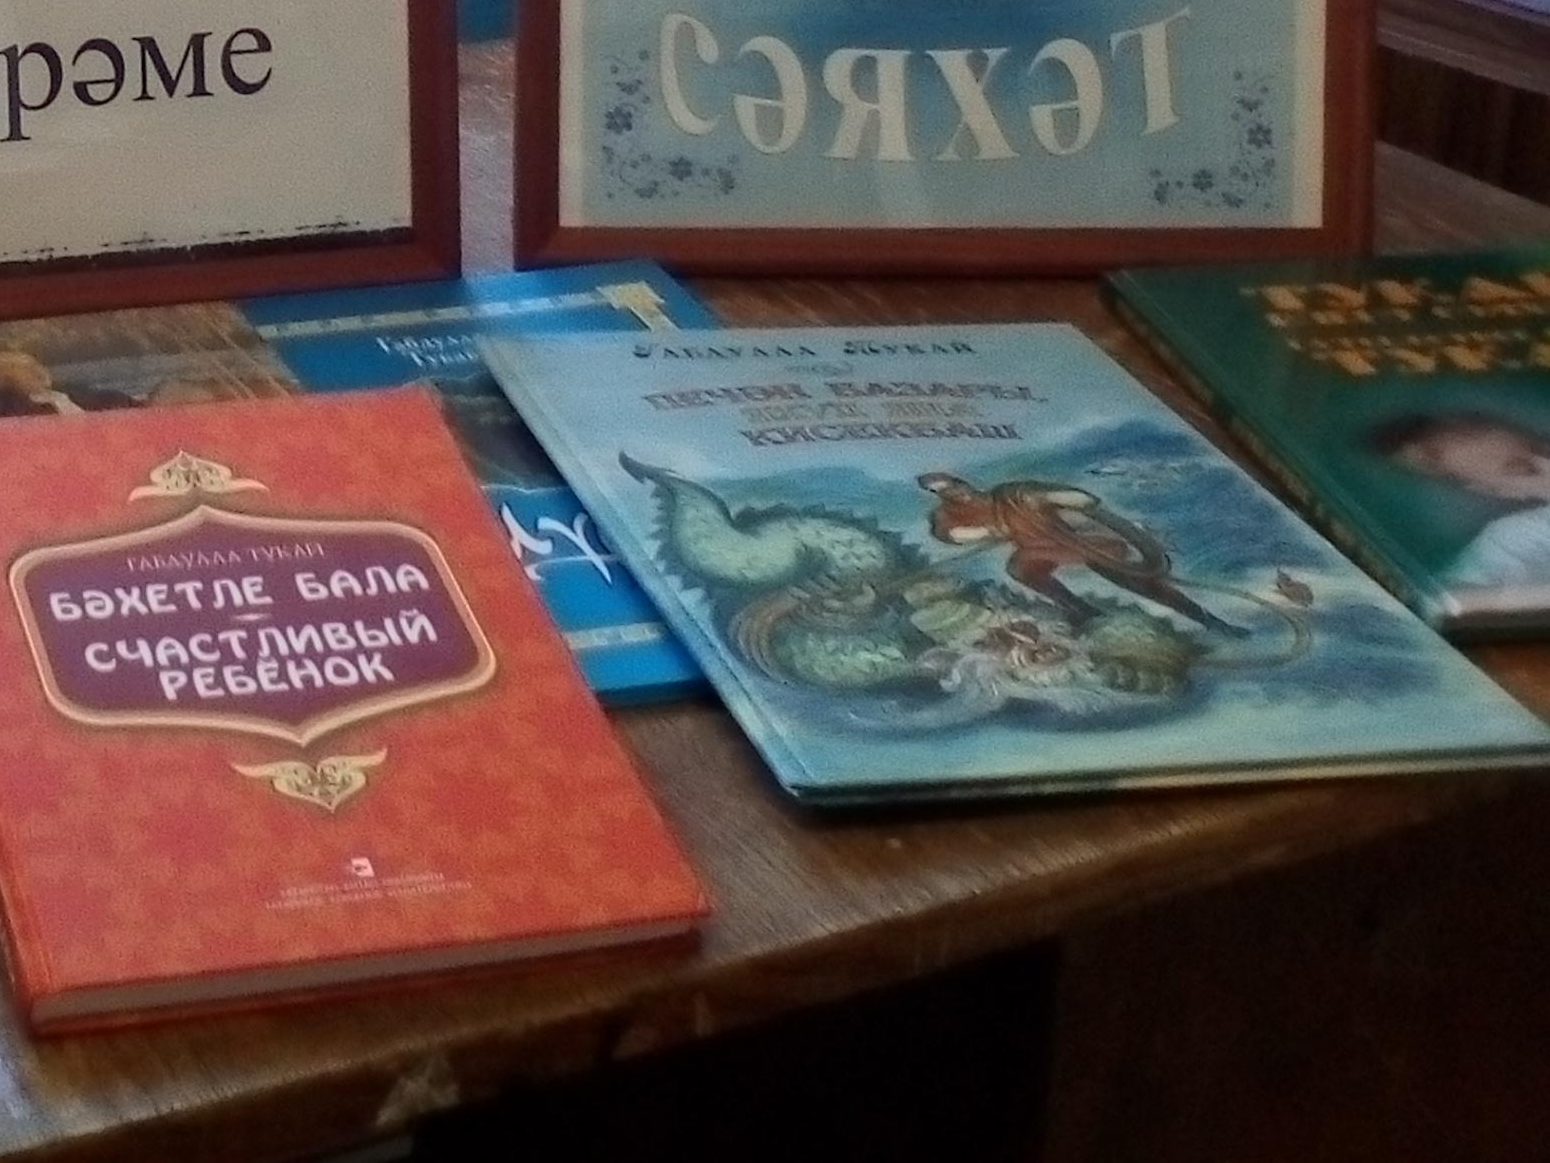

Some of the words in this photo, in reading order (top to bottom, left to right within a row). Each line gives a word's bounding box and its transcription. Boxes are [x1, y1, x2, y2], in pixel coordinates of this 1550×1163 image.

[50, 576, 274, 622] БӘХЕТЛЕ
[295, 563, 431, 602] БАЛА
[84, 608, 439, 673] СЧАСТЛИВЫЙ
